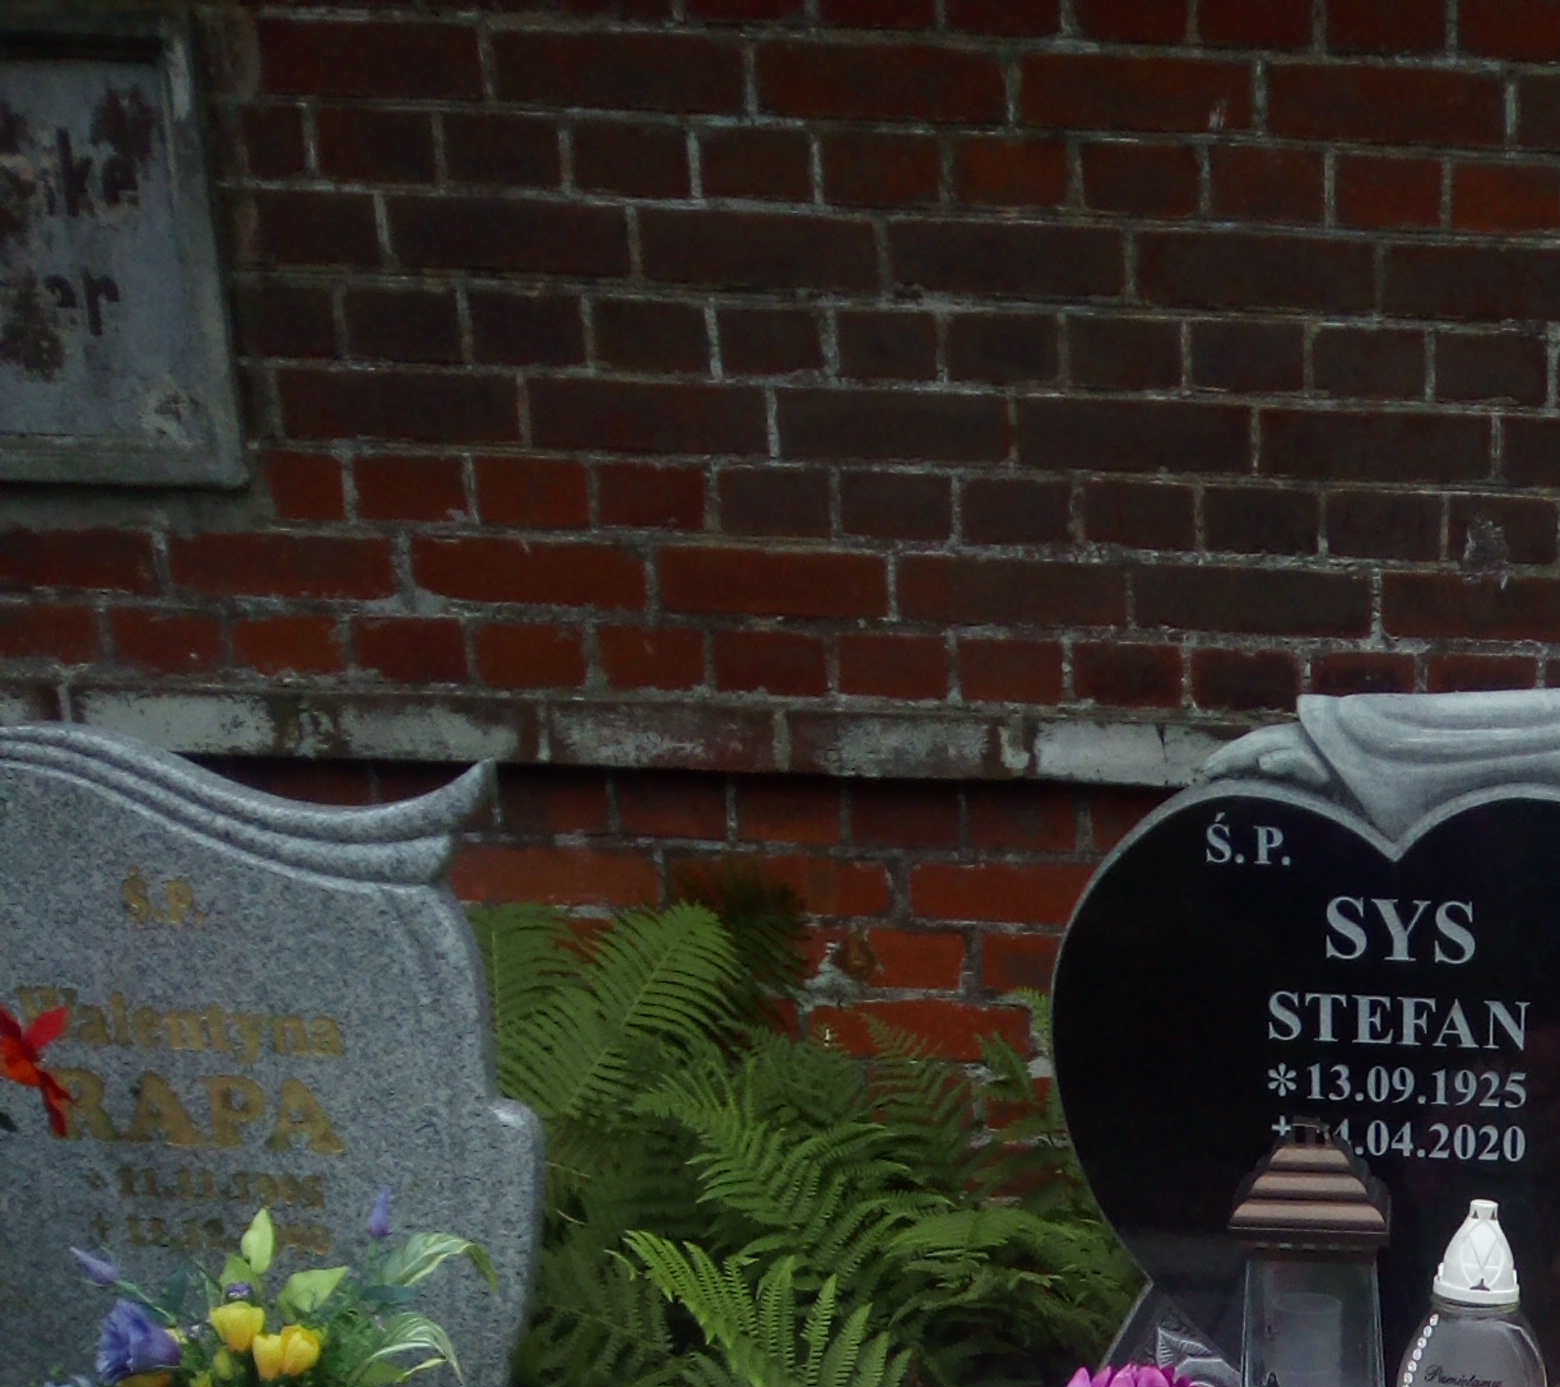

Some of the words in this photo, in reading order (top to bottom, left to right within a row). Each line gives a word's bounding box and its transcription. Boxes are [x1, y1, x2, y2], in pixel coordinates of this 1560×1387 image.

[1325, 896, 1476, 964] SYS
[1267, 991, 1531, 1051] STEFAN
[1306, 1117, 1527, 1163] 4.04.2020
